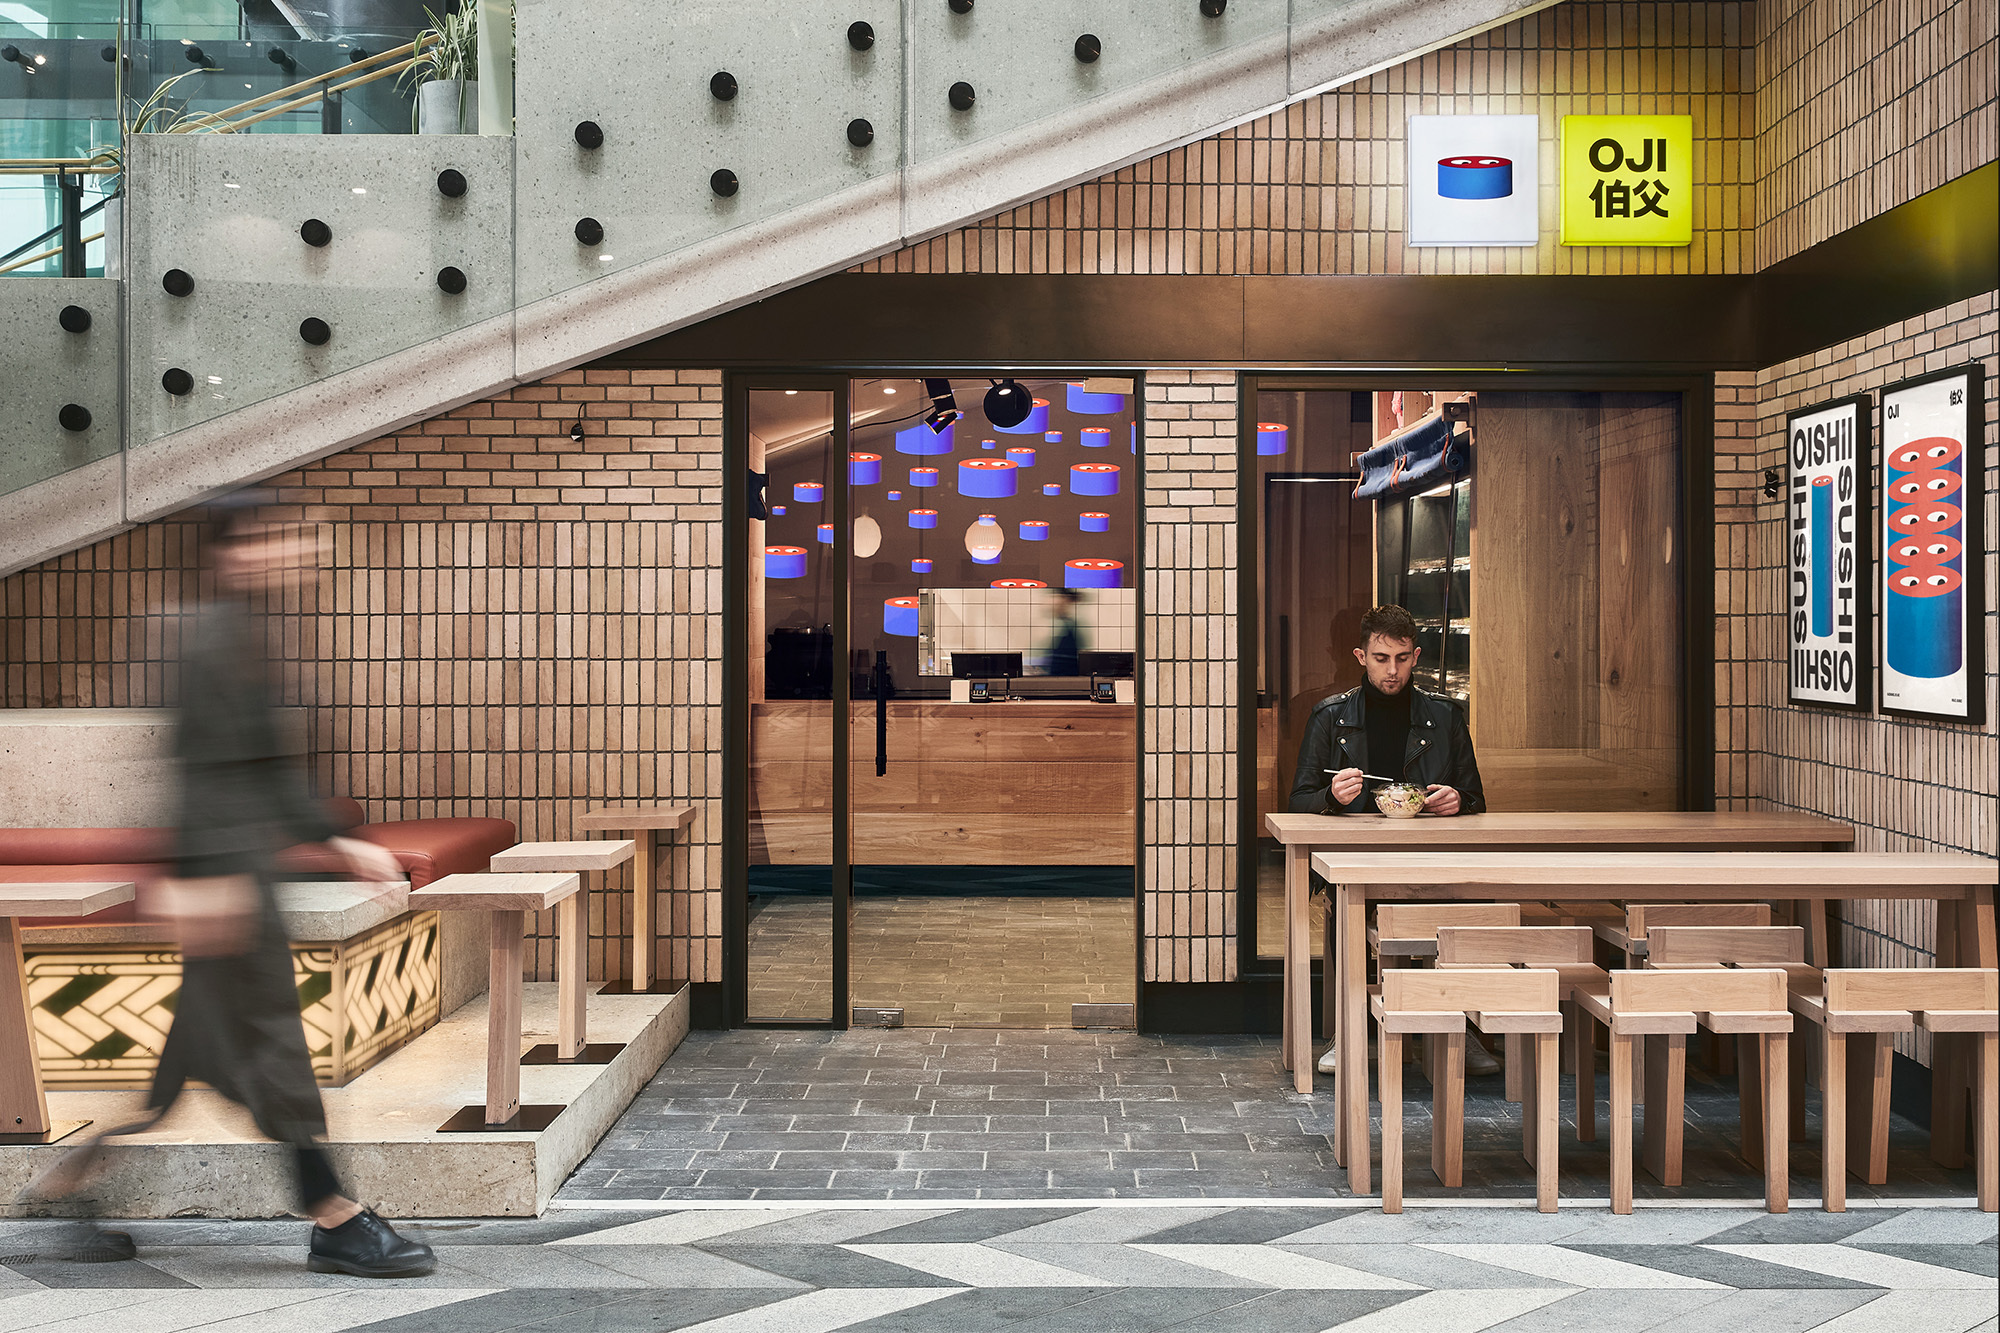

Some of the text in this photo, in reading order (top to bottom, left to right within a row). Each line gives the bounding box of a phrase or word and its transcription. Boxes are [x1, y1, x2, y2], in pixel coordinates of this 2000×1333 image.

[1589, 138, 1667, 172] OJI
[1589, 179, 1669, 218] 伯父
[1887, 403, 1900, 419] OJI
[1949, 388, 1963, 406] 伯父
[1793, 417, 1853, 470] OISHII
[1793, 475, 1807, 645] SUSHI
[1838, 466, 1853, 644] SUSHI
[1794, 649, 1853, 693] OISHII
